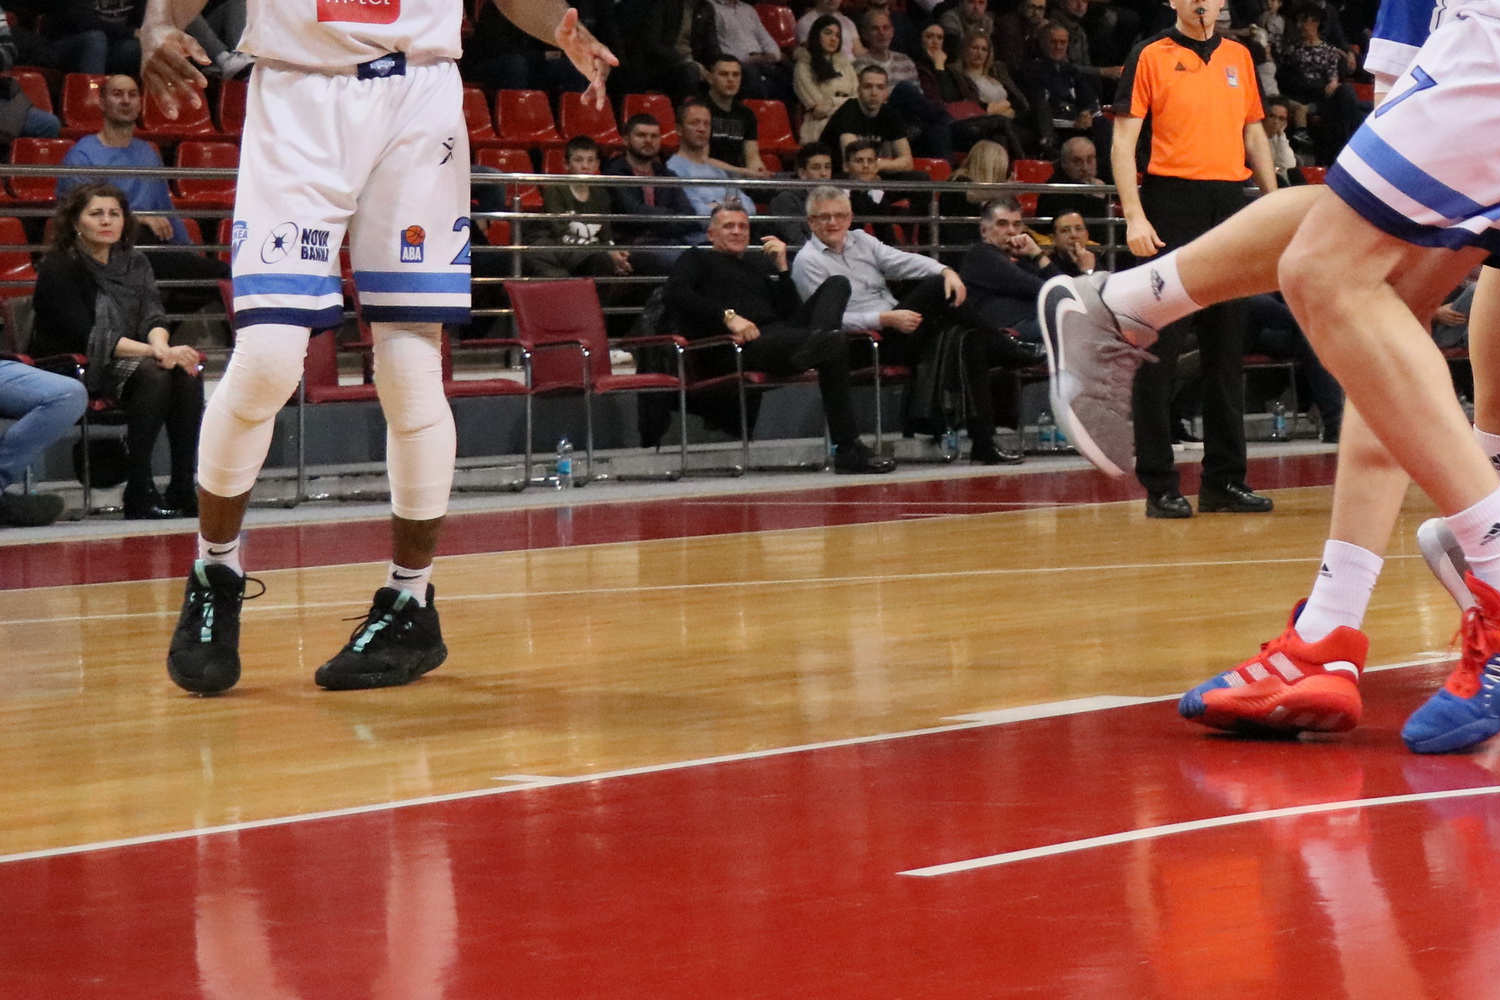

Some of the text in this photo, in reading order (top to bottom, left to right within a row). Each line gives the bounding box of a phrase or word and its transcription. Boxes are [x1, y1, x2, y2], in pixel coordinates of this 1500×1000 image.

[301, 228, 330, 247] NOVA
[450, 216, 471, 266] 2
[402, 247, 422, 262] ABA
